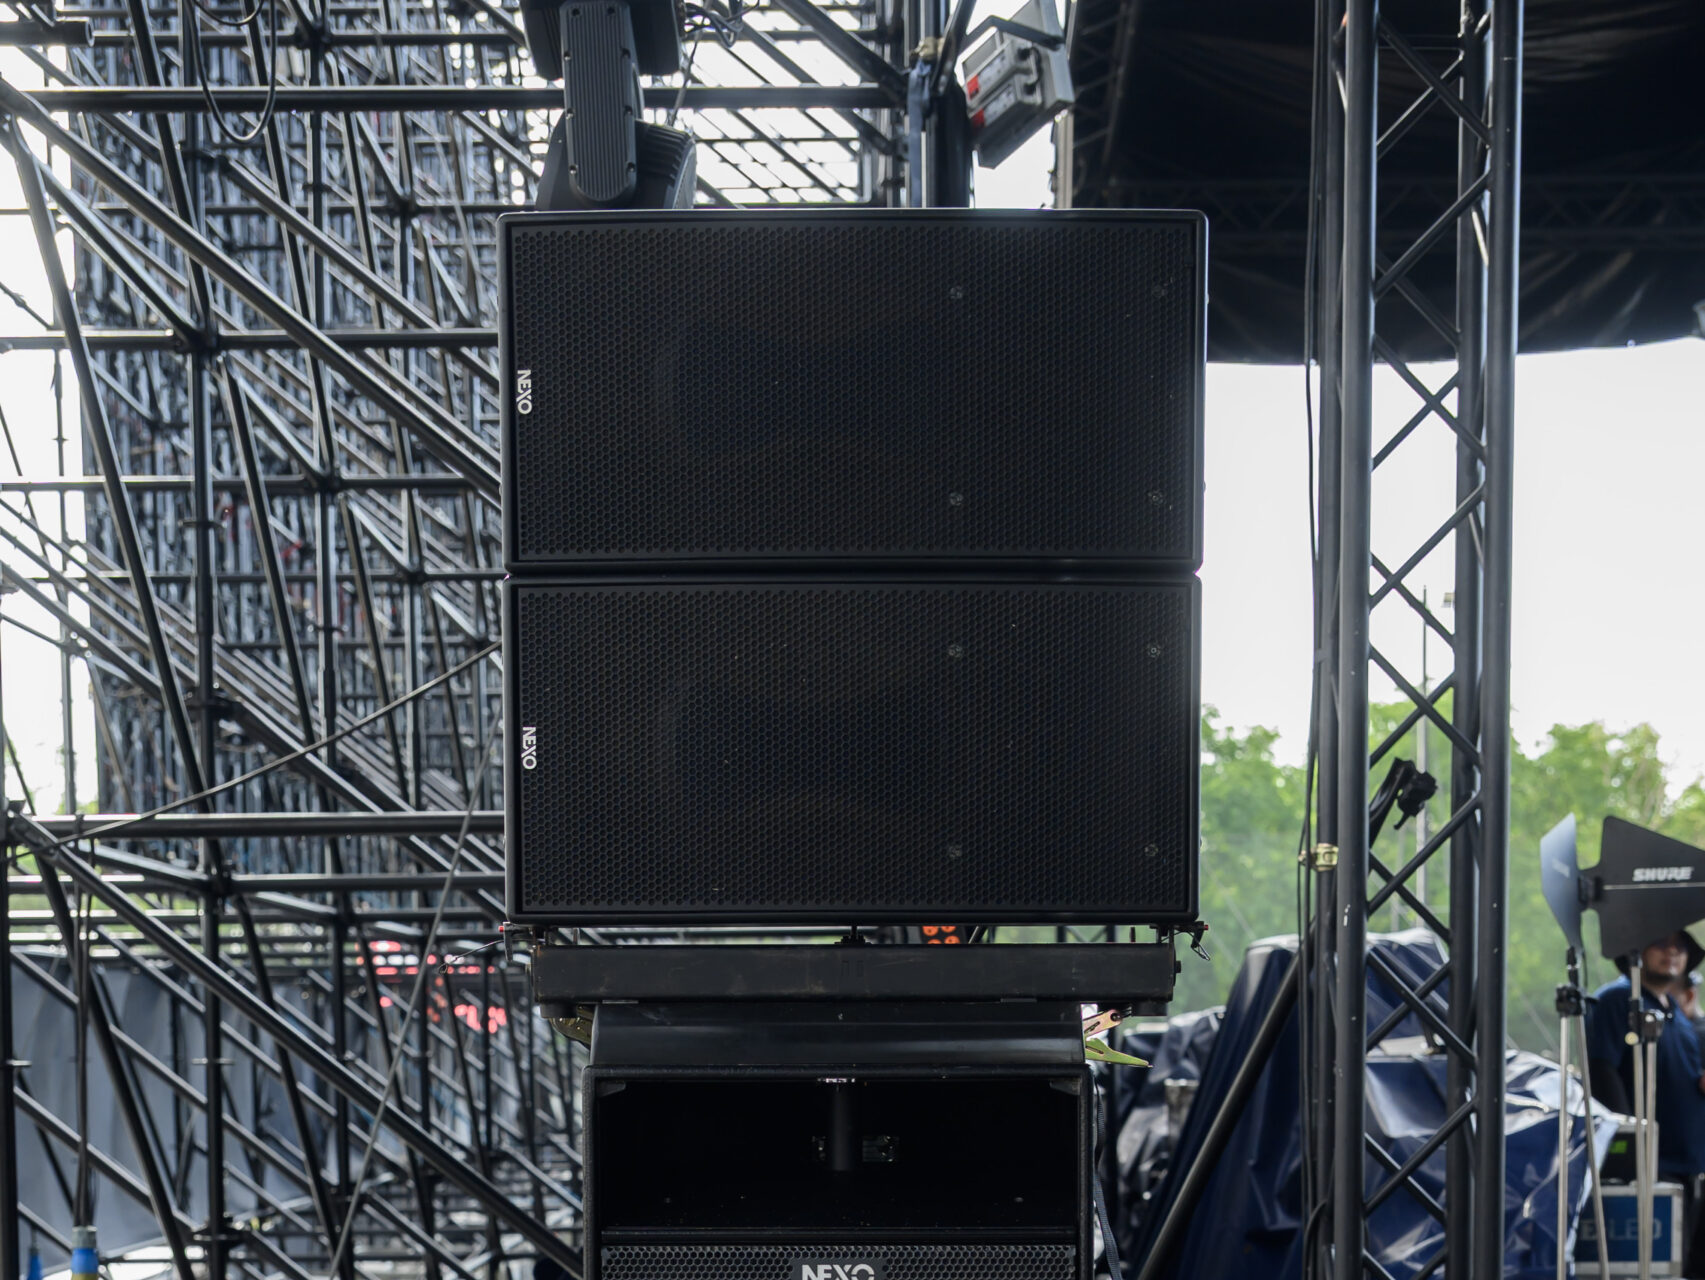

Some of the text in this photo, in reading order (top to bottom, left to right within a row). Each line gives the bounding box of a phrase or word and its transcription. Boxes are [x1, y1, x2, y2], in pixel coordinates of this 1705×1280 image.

[516, 369, 532, 415] NEXO
[521, 726, 537, 770] NEXO
[1632, 866, 1693, 882] SHURE
